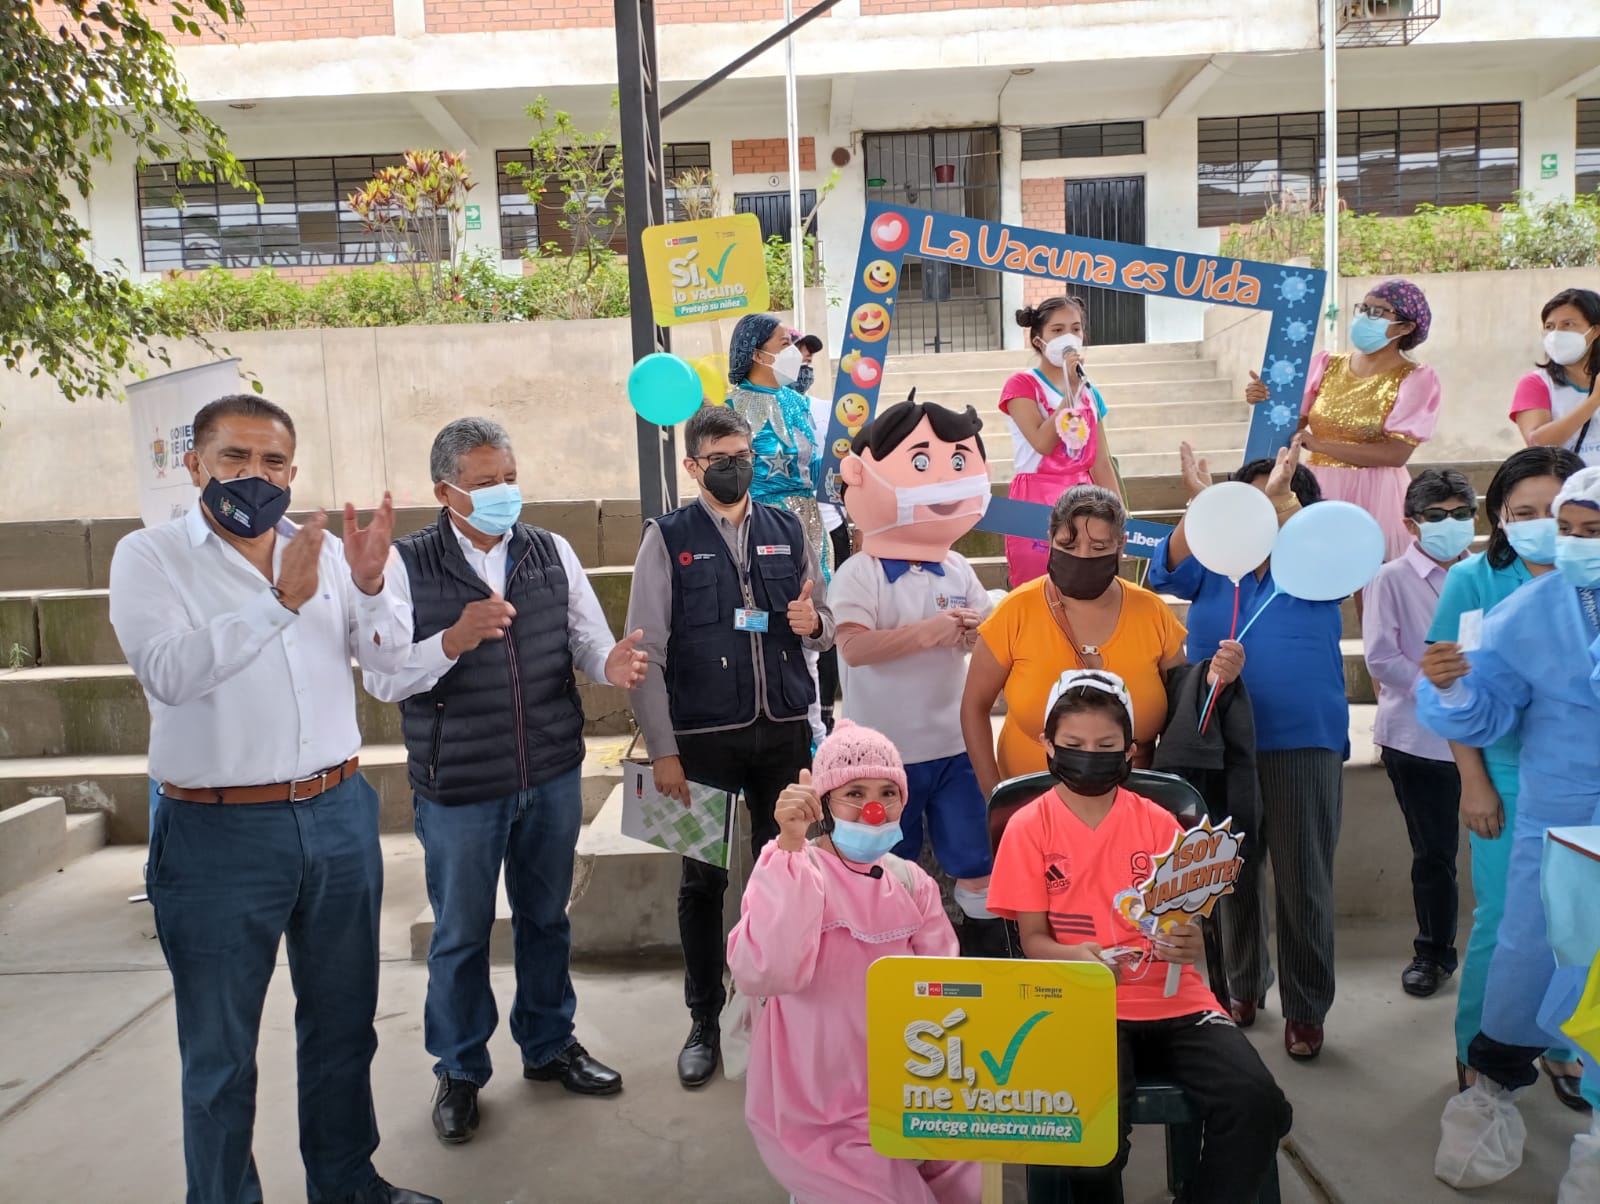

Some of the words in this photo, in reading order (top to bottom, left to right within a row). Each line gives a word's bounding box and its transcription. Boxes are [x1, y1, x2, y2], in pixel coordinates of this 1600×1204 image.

[669, 249, 707, 289] Sí,
[919, 215, 971, 260] La
[1121, 259, 1168, 292] es
[672, 288, 688, 304] lo
[691, 282, 748, 302] vacuno.
[681, 302, 709, 315] Protejo
[710, 302, 719, 310] su
[720, 299, 741, 309] niñez
[1126, 531, 1165, 547] Liber
[1173, 835, 1223, 872] ¡SOY
[1144, 858, 1241, 913] VALIENTE!
[1034, 985, 1063, 994] Siempre
[903, 1007, 977, 1087] Sí,
[903, 1083, 953, 1110] me
[960, 1087, 1079, 1114] vacuno.
[909, 1116, 967, 1137] Protege
[970, 1117, 1029, 1136] nuestra
[1031, 1120, 1073, 1138] niñez
